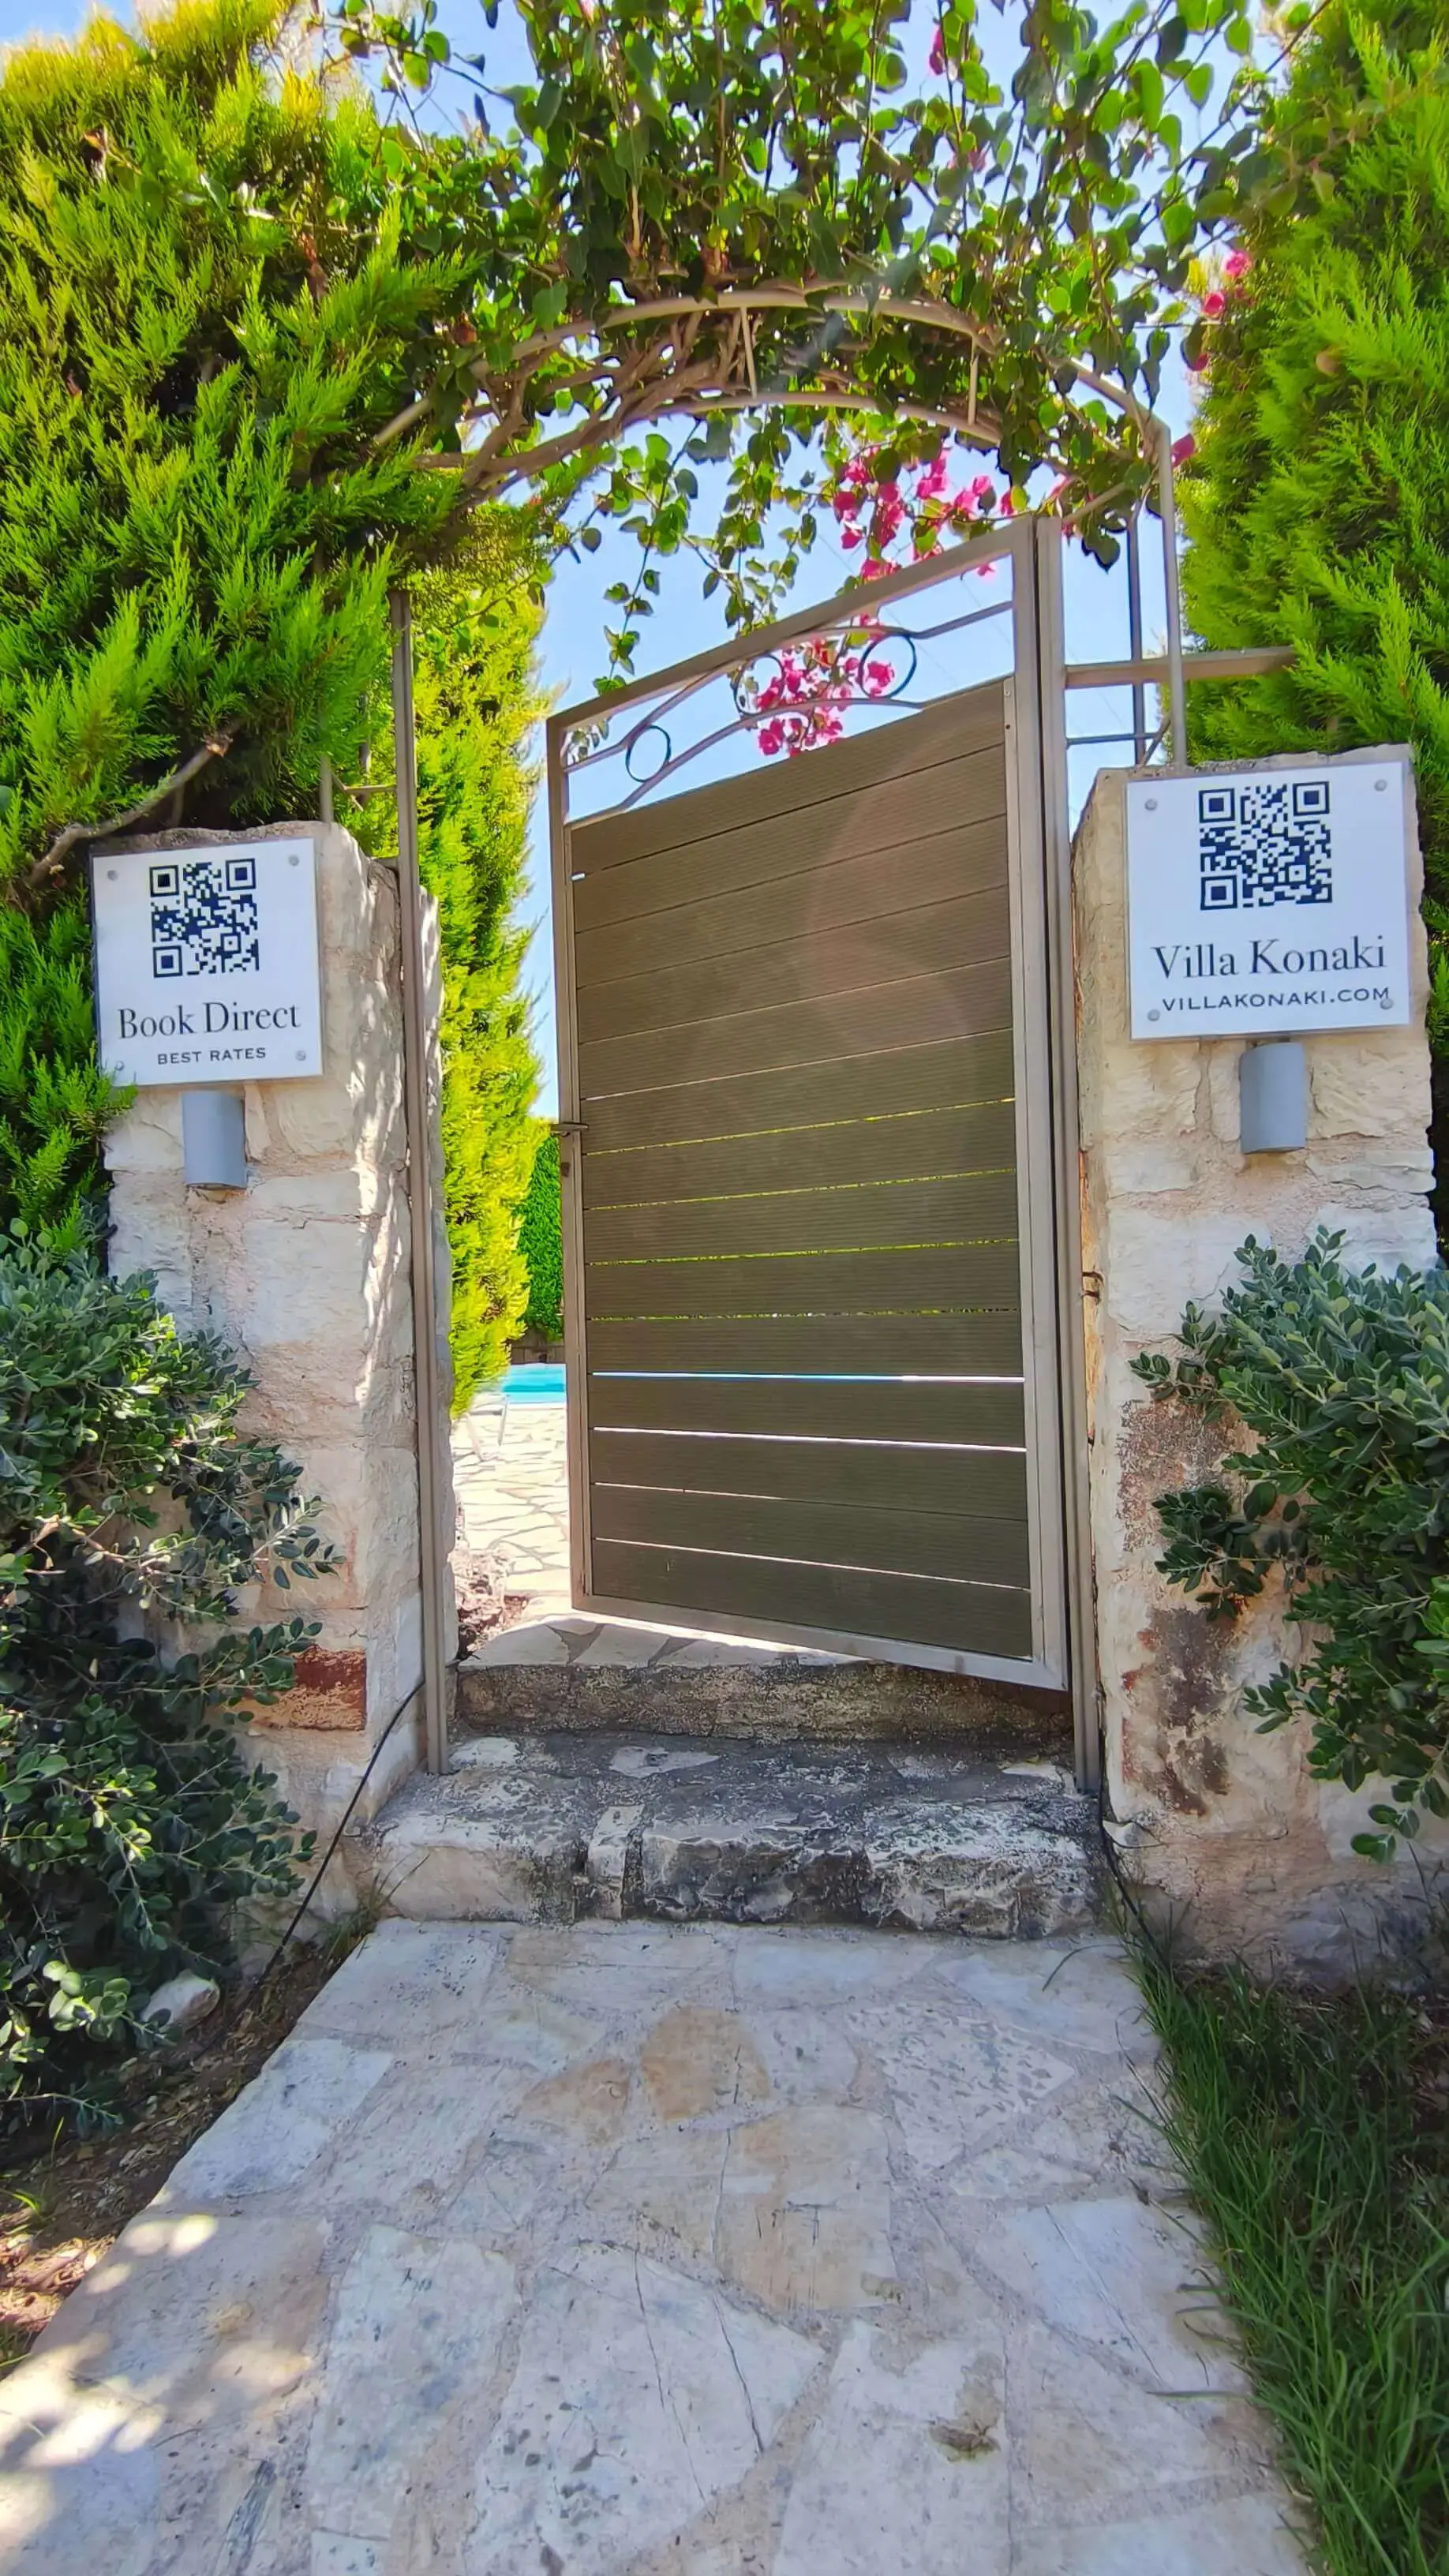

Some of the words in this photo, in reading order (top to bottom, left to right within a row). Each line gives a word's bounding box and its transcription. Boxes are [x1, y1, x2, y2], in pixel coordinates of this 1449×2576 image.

[1151, 943, 1239, 979] Villa
[1249, 935, 1388, 975] Konaki
[1163, 987, 1390, 1011] VILLAKONAKI.COM
[118, 1005, 197, 1039] Book
[203, 1001, 301, 1032] Direct
[158, 1051, 202, 1065] BEST
[210, 1047, 266, 1062] RATES
